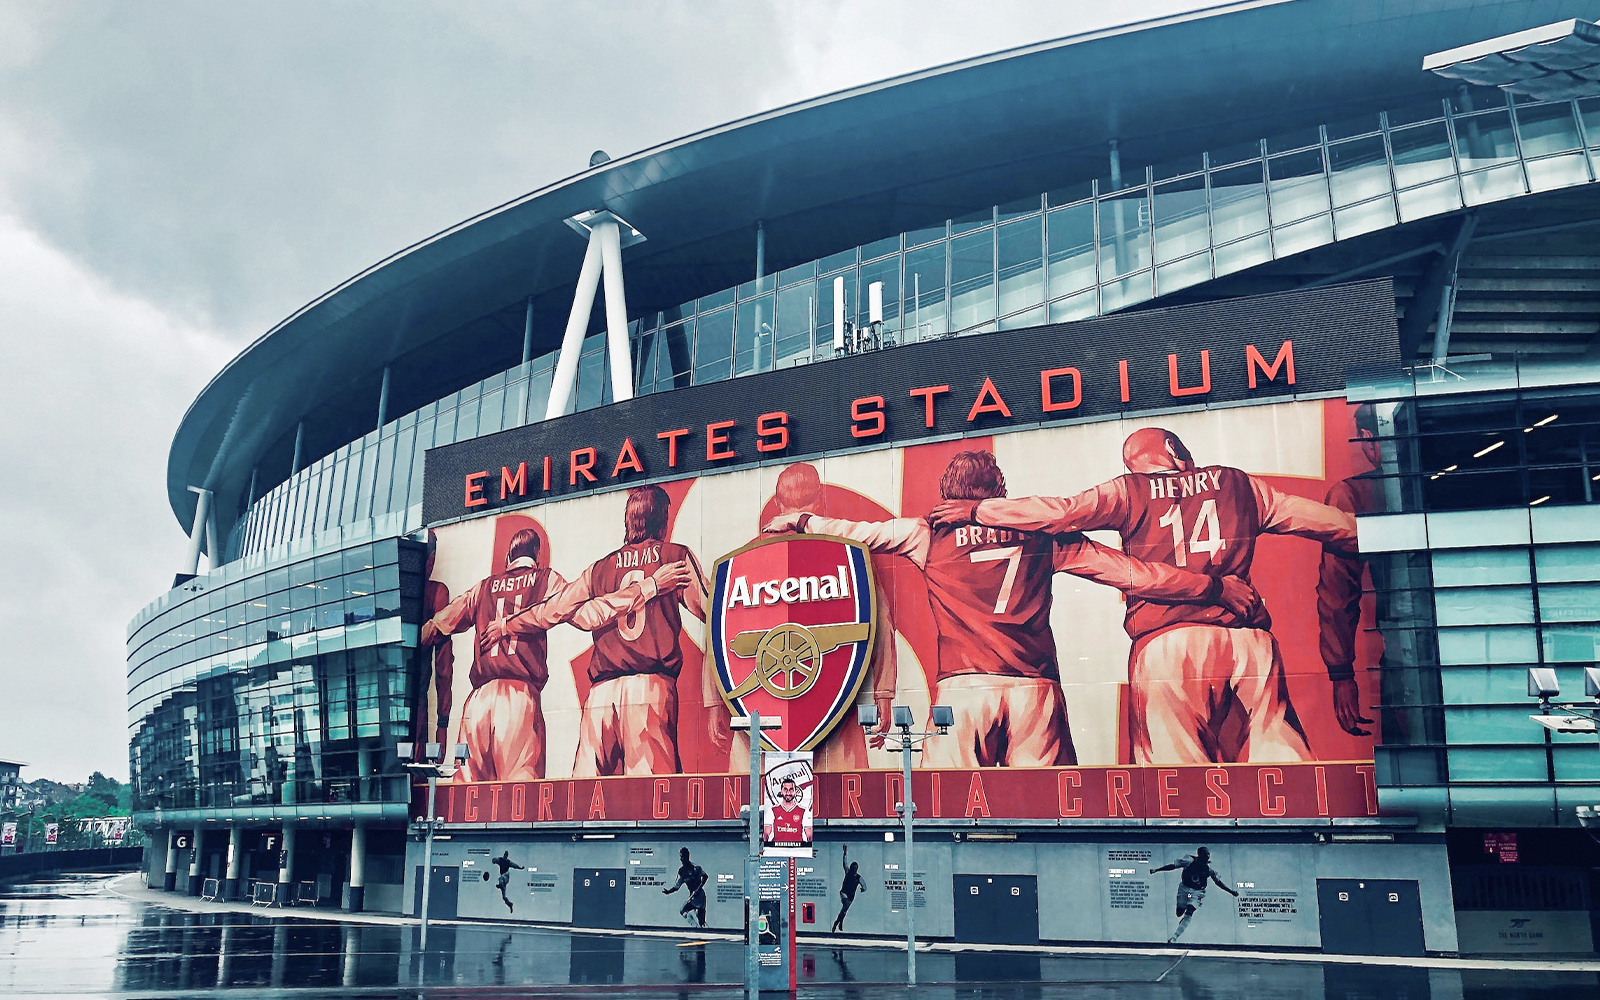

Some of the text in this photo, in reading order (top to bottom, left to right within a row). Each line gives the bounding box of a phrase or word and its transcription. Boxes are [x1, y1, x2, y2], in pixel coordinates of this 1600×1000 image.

[464, 340, 1297, 507] EMIRATES STADIUM
[1149, 469, 1222, 500] HENRY
[955, 525, 1025, 546] BRAD
[1159, 498, 1227, 567] 14
[615, 544, 661, 570] ADAMS
[491, 572, 538, 594] BASTIN
[728, 564, 851, 610] Arsenal
[969, 546, 1024, 615] 7
[772, 768, 806, 787] Arsenal
[652, 772, 991, 820] CONRDIA
[176, 836, 187, 848] G
[266, 837, 275, 850] F
